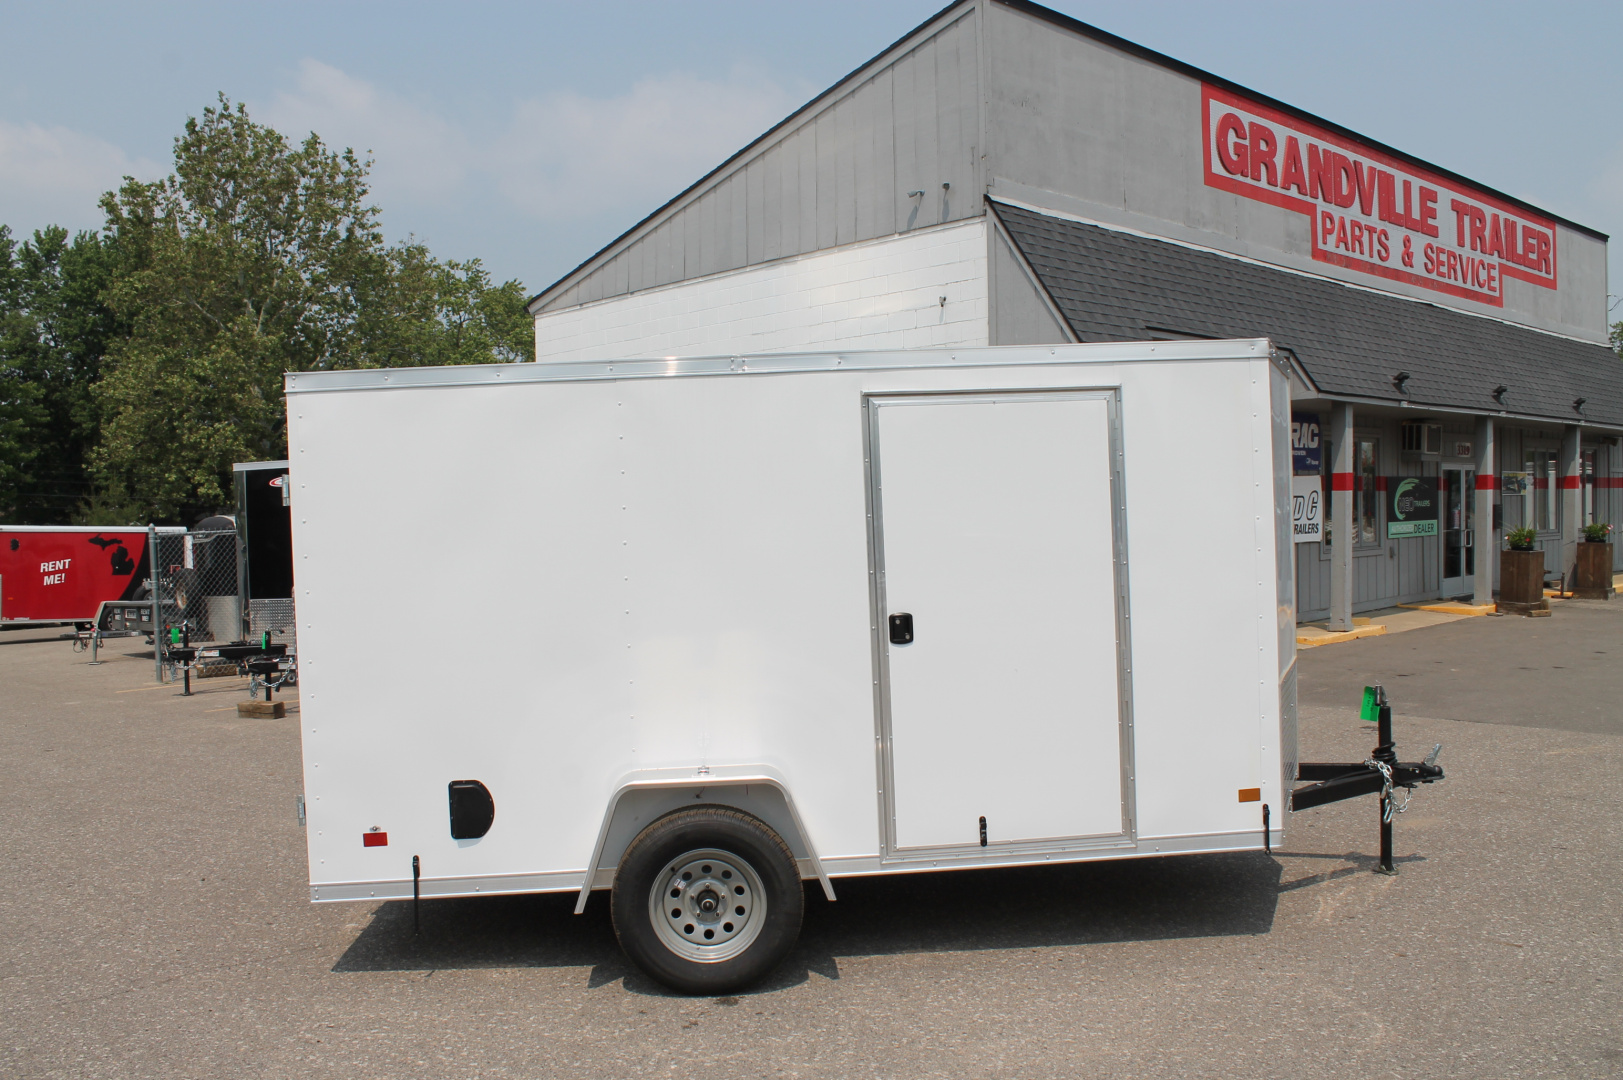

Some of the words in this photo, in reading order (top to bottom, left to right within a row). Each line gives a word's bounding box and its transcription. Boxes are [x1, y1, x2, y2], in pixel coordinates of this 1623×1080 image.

[1216, 112, 1439, 238] GRANDVILLE
[1451, 198, 1552, 275] TRAILER
[1321, 210, 1390, 262] PARTS
[1402, 234, 1414, 268] &
[1423, 242, 1497, 292] SERVICE
[1291, 422, 1319, 449] RAC
[1293, 523, 1319, 535] RAILERS
[1413, 523, 1435, 534] DEALER
[40, 559, 72, 573] RENT
[43, 573, 65, 586] ME!
